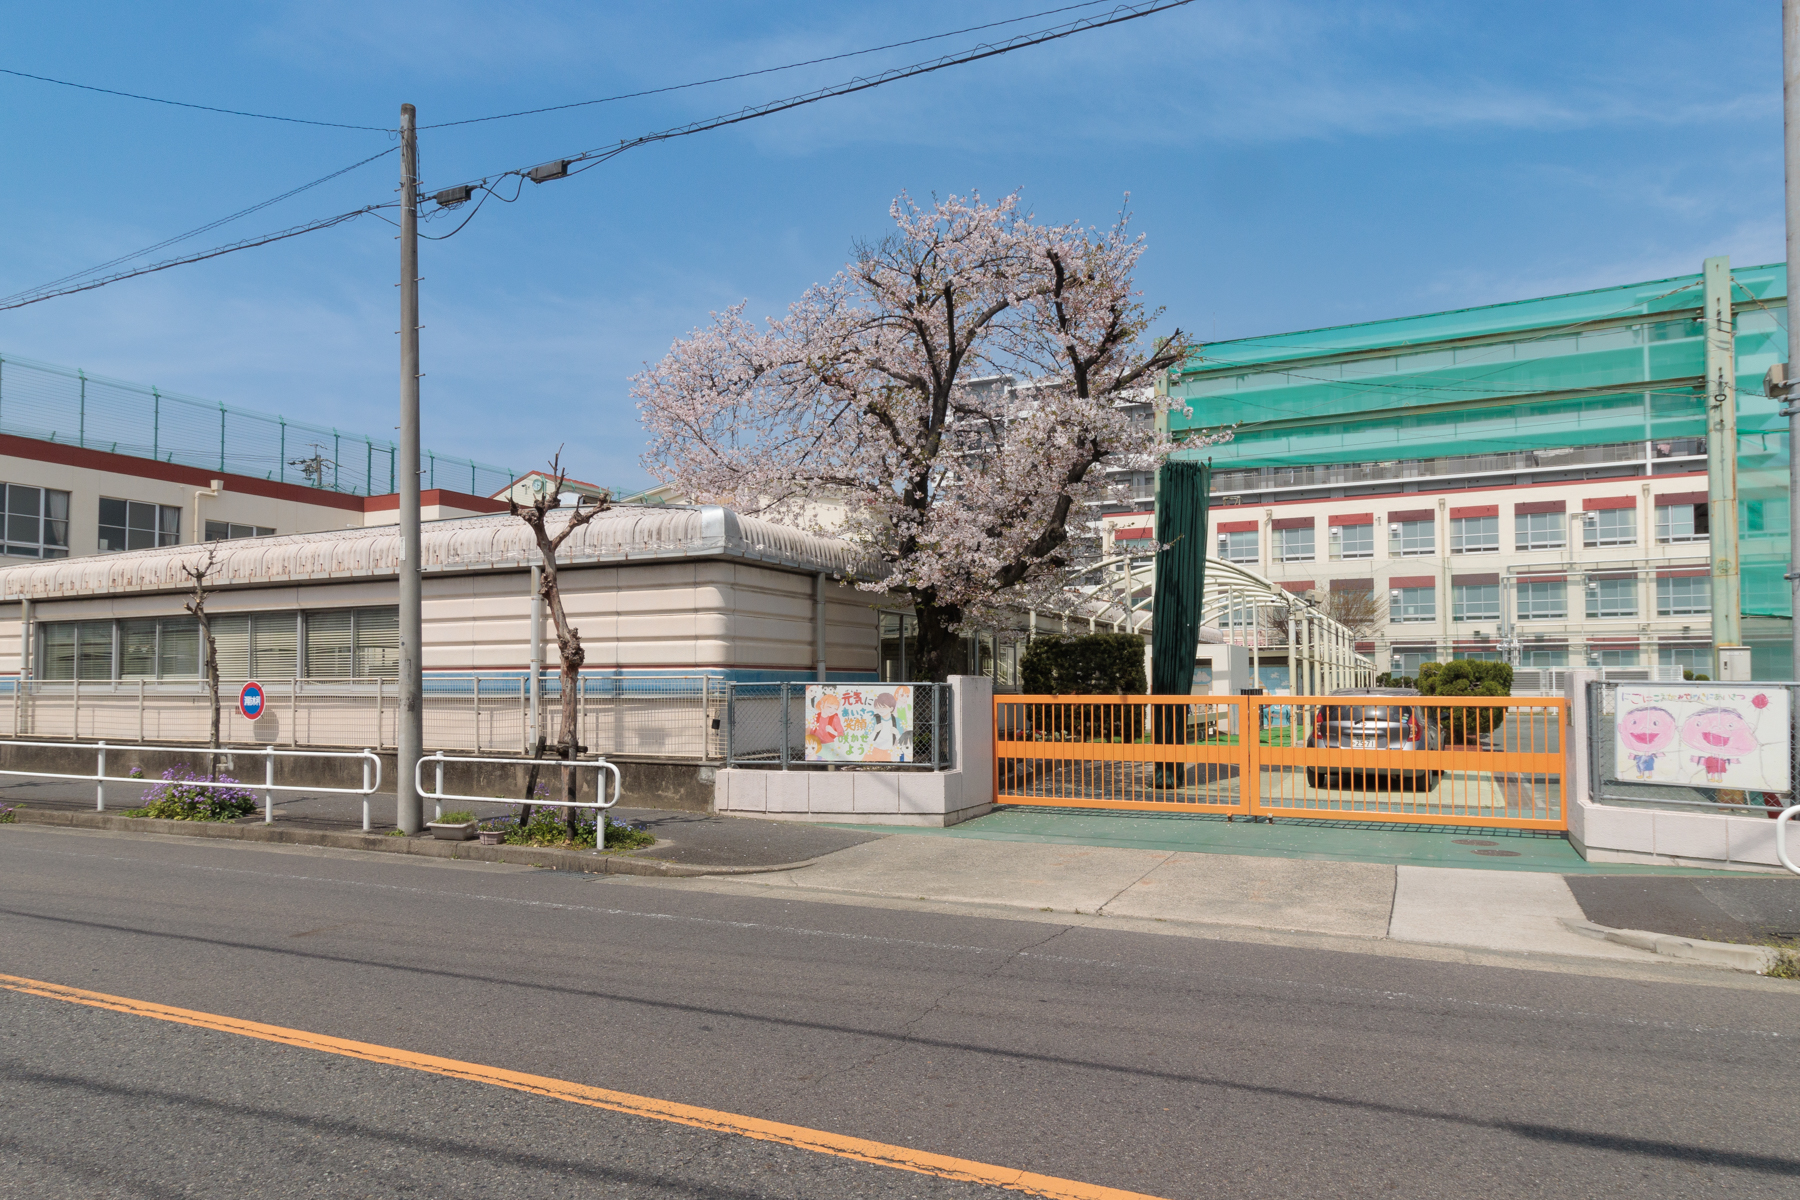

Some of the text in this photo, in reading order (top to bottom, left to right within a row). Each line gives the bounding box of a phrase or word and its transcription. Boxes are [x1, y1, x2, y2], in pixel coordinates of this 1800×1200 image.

[842, 692, 874, 706] 元気に
[841, 707, 875, 717] あいさつ
[843, 718, 867, 731] 笑顔
[838, 732, 869, 744] 咲かせ
[845, 744, 865, 755] よう
